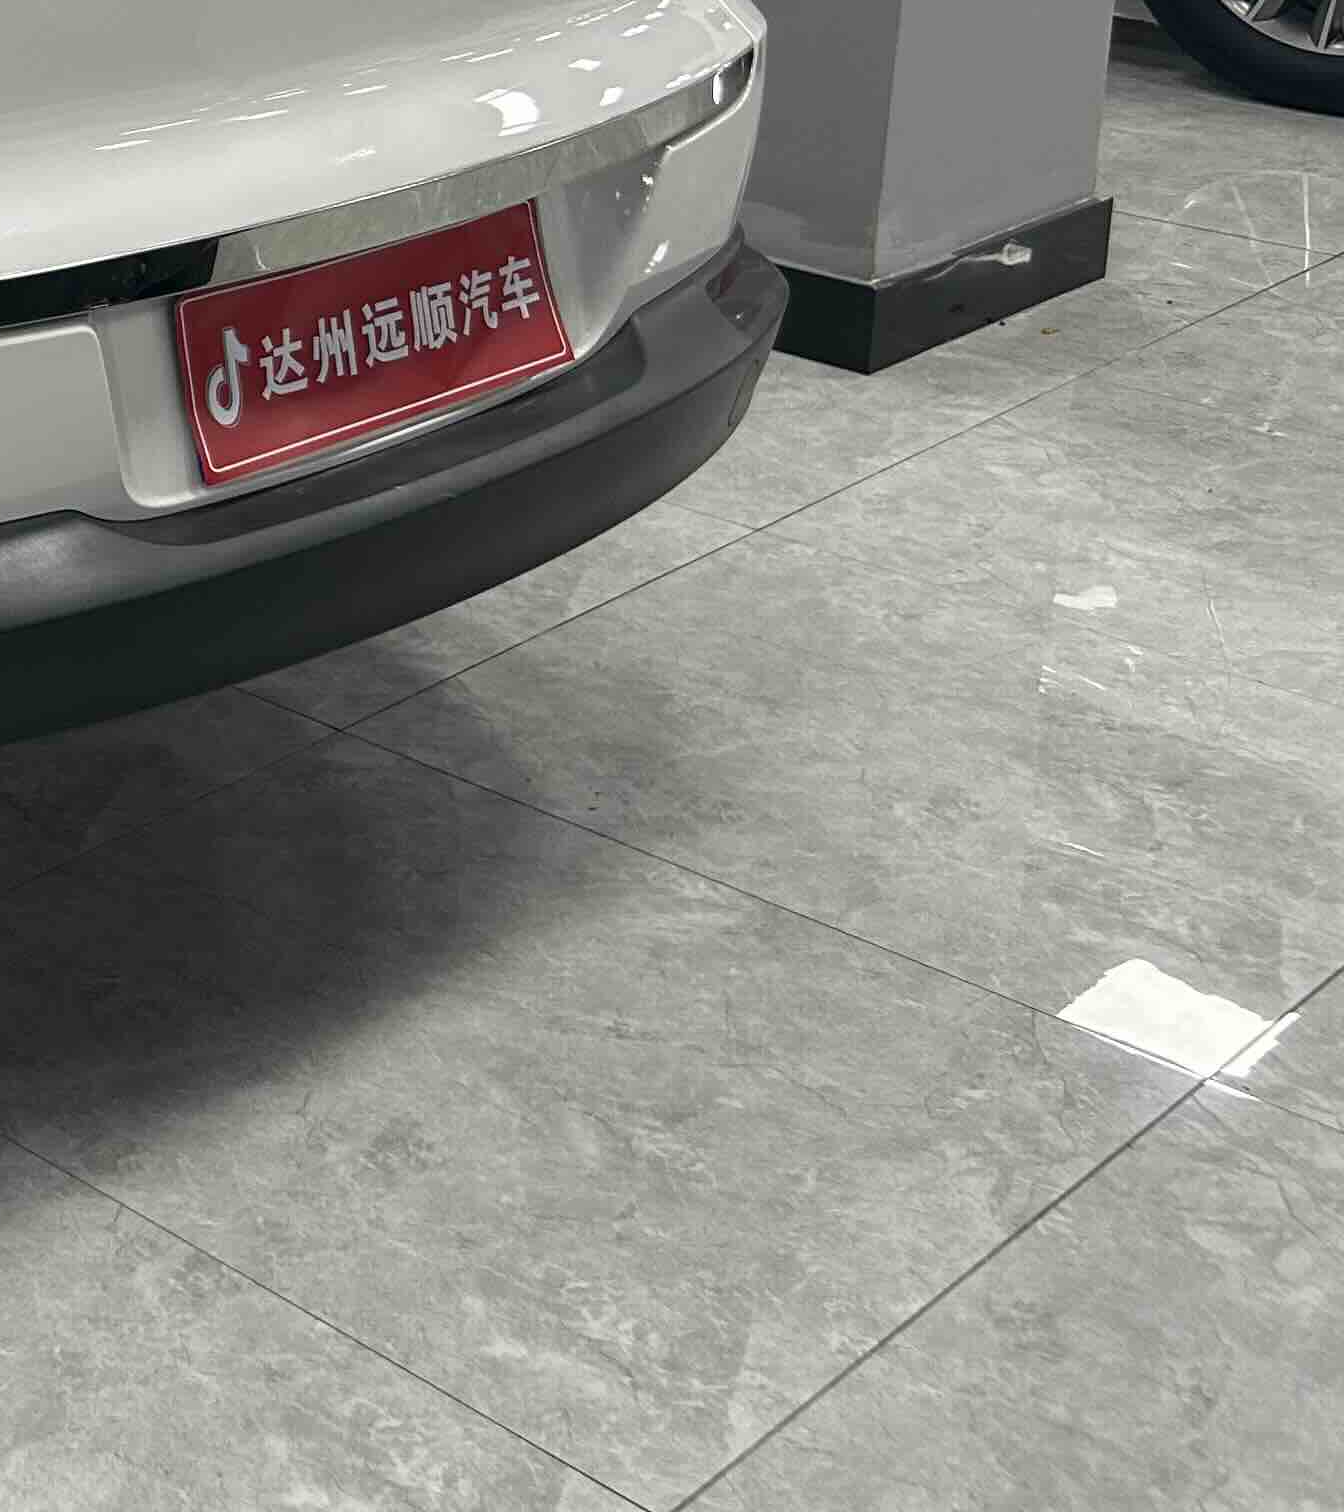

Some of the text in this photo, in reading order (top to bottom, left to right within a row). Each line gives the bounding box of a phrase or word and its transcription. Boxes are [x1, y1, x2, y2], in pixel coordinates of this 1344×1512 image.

[259, 256, 541, 401] 达州远顺汽车
